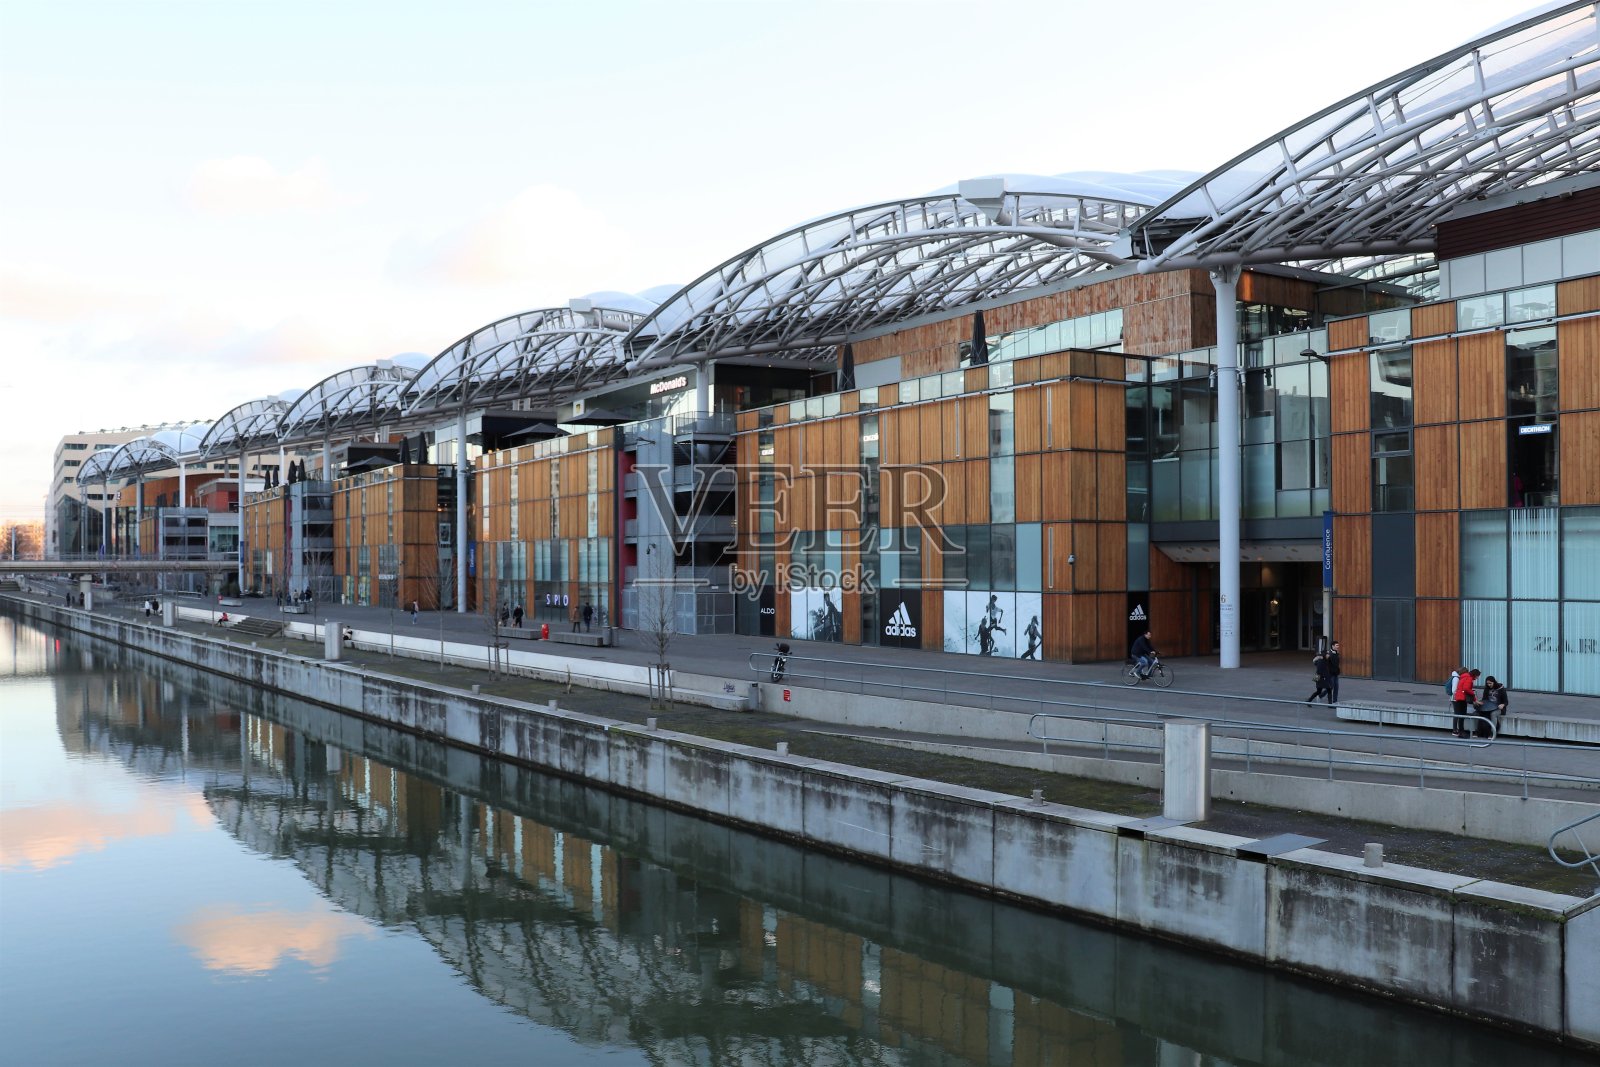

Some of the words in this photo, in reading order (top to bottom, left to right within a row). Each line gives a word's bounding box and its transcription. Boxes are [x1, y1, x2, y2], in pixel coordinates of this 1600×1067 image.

[649, 376, 687, 395] McDonald's
[1520, 425, 1551, 434] DECATHLON
[760, 607, 775, 615] ALDO
[885, 624, 917, 637] adidas
